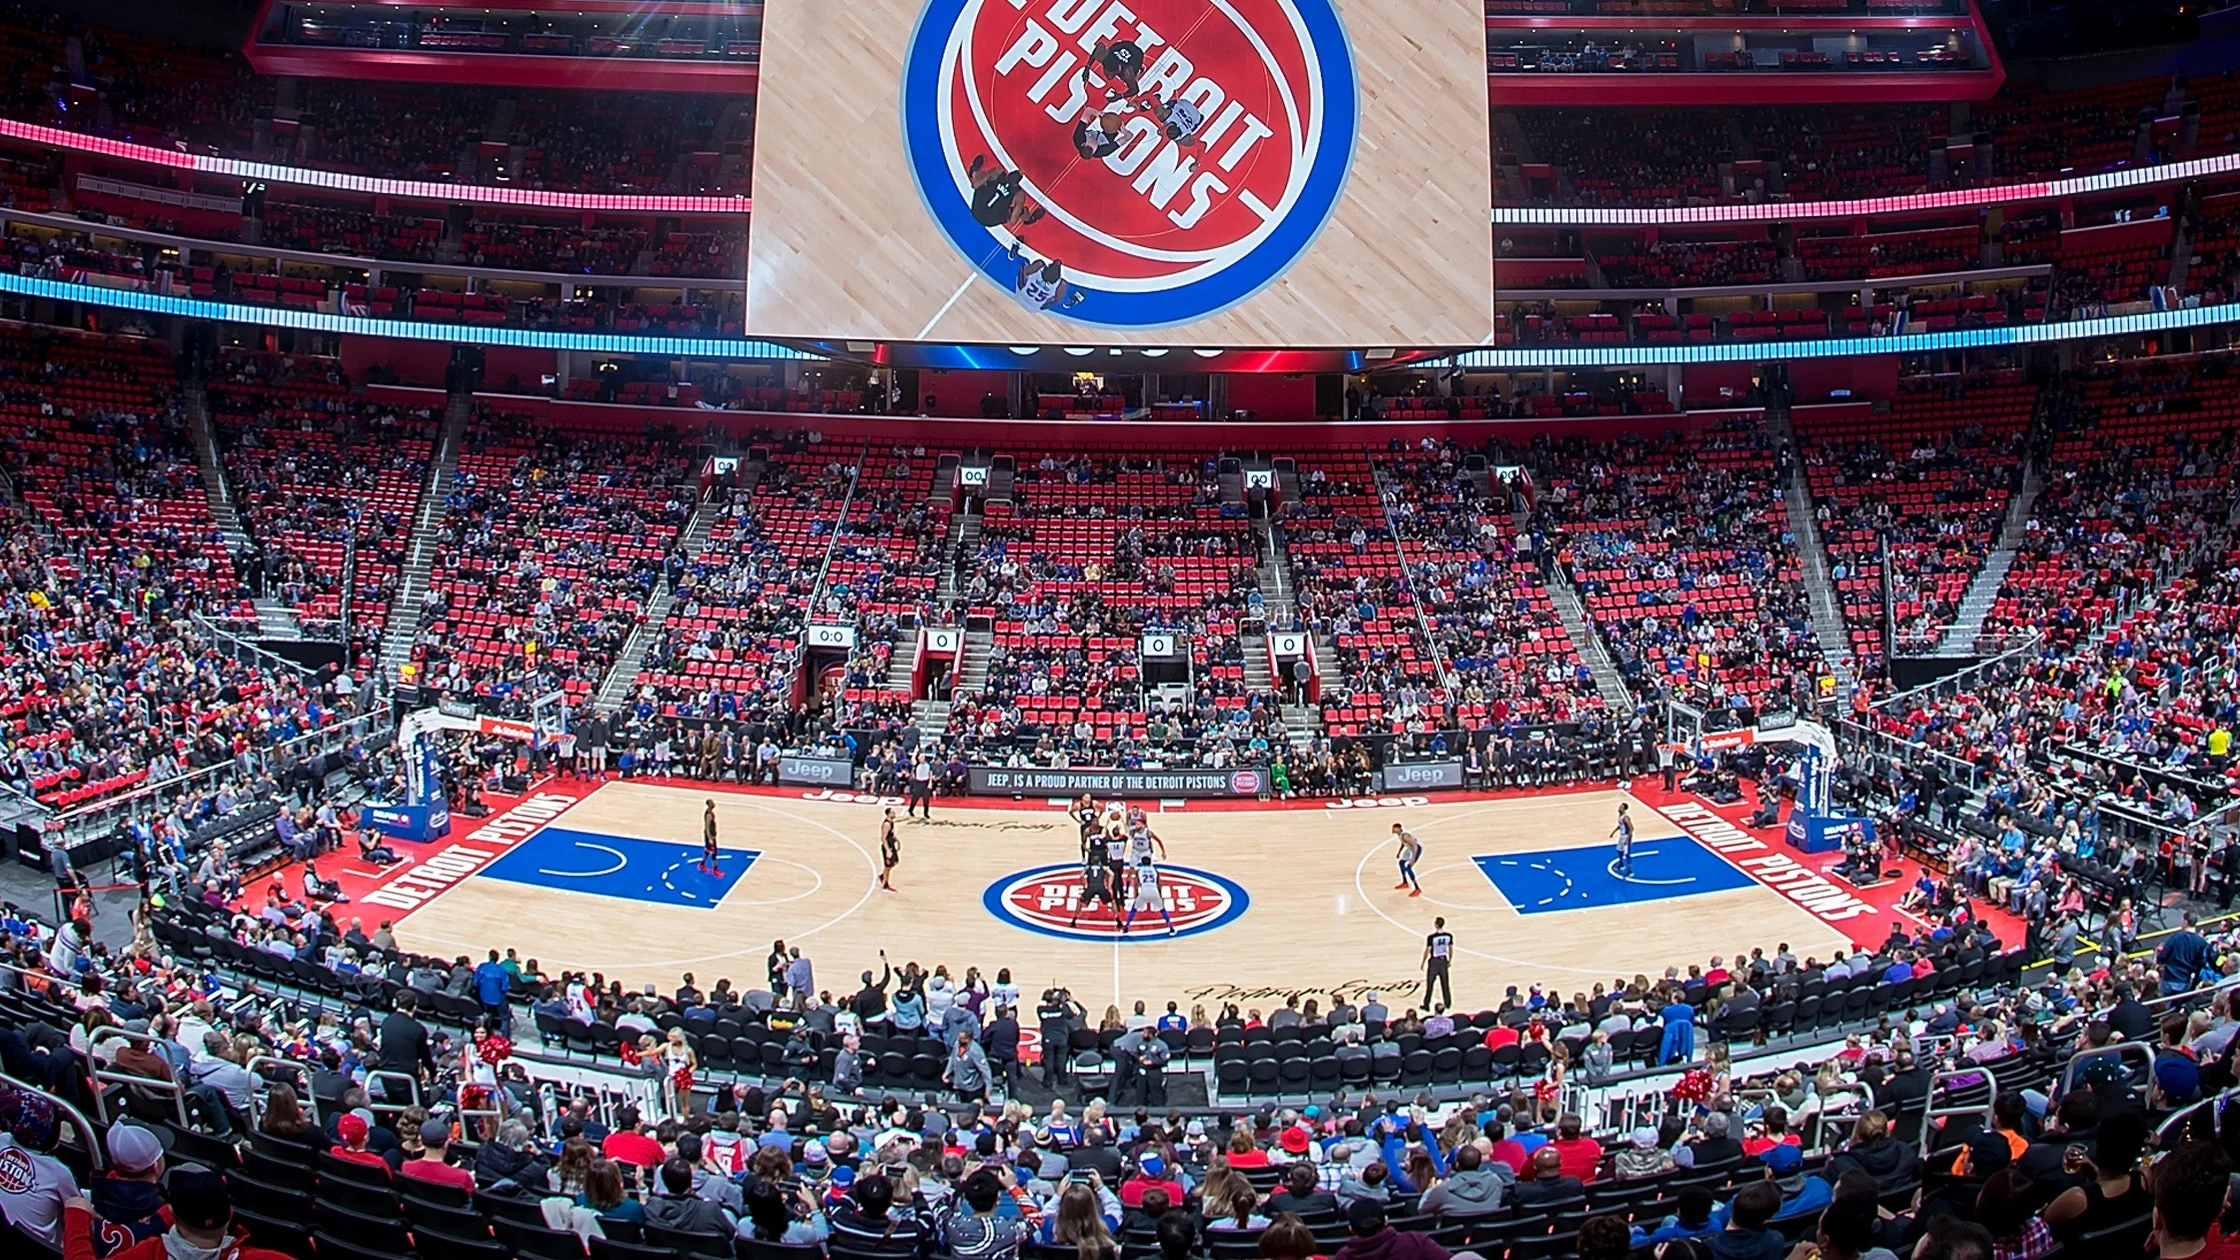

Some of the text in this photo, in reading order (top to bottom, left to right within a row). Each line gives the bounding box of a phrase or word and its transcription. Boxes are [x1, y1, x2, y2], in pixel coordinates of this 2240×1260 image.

[1025, 282, 1048, 302] 25
[443, 702, 471, 716] Jeep
[1763, 715, 1791, 727] Jeep
[787, 763, 833, 780] Jeep
[1397, 768, 1444, 784] Jeep
[1014, 774, 1024, 788] IS
[1026, 775, 1033, 788] A
[1035, 774, 1066, 788] PROUD
[1068, 775, 1110, 789] PARTNER
[1112, 775, 1125, 789] OF
[1126, 776, 1144, 789] THE
[1145, 776, 1184, 789] DETROIT
[1186, 776, 1226, 789] PISTONS
[801, 788, 905, 807] Jeep
[1325, 796, 1429, 809] Jeep
[359, 791, 578, 910] DETROIT PISTONS
[1657, 801, 1879, 921] DETROIT PISTONS
[1142, 874, 1155, 883] 25
[0, 1159, 37, 1192] ISTONS
